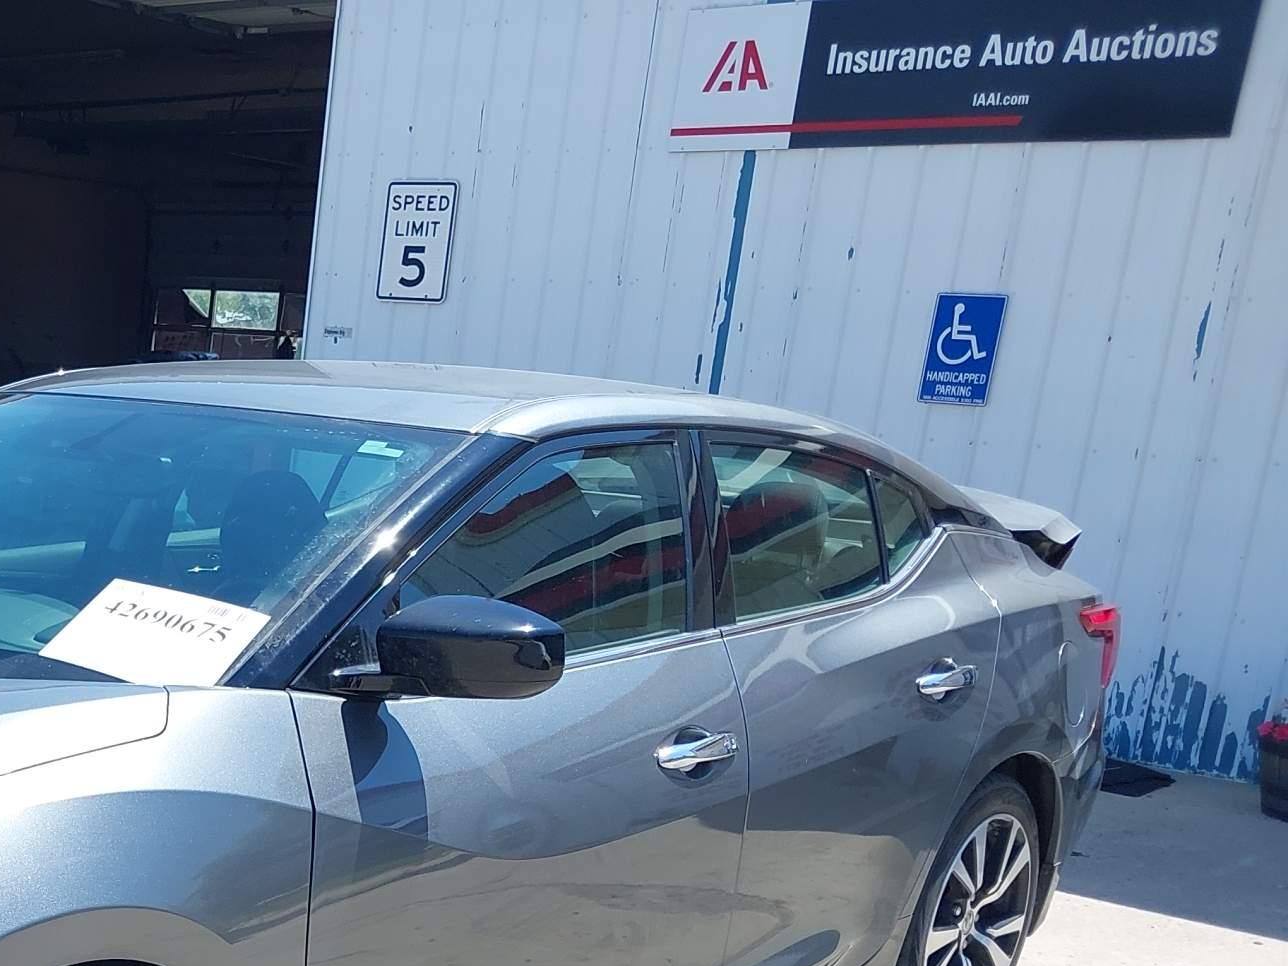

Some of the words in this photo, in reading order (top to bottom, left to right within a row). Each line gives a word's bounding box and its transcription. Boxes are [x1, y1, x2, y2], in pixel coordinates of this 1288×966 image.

[826, 43, 971, 76] Insurance
[978, 34, 1054, 68] Auto
[1062, 23, 1219, 63] Auctions
[972, 92, 1029, 108] IAAI.com
[391, 194, 450, 212] SPEED
[394, 219, 441, 237] LIMIT
[398, 245, 426, 288] 5
[926, 370, 986, 384] HANDICAPPED
[934, 384, 972, 397] PARKING
[104, 600, 233, 643] 42690675
